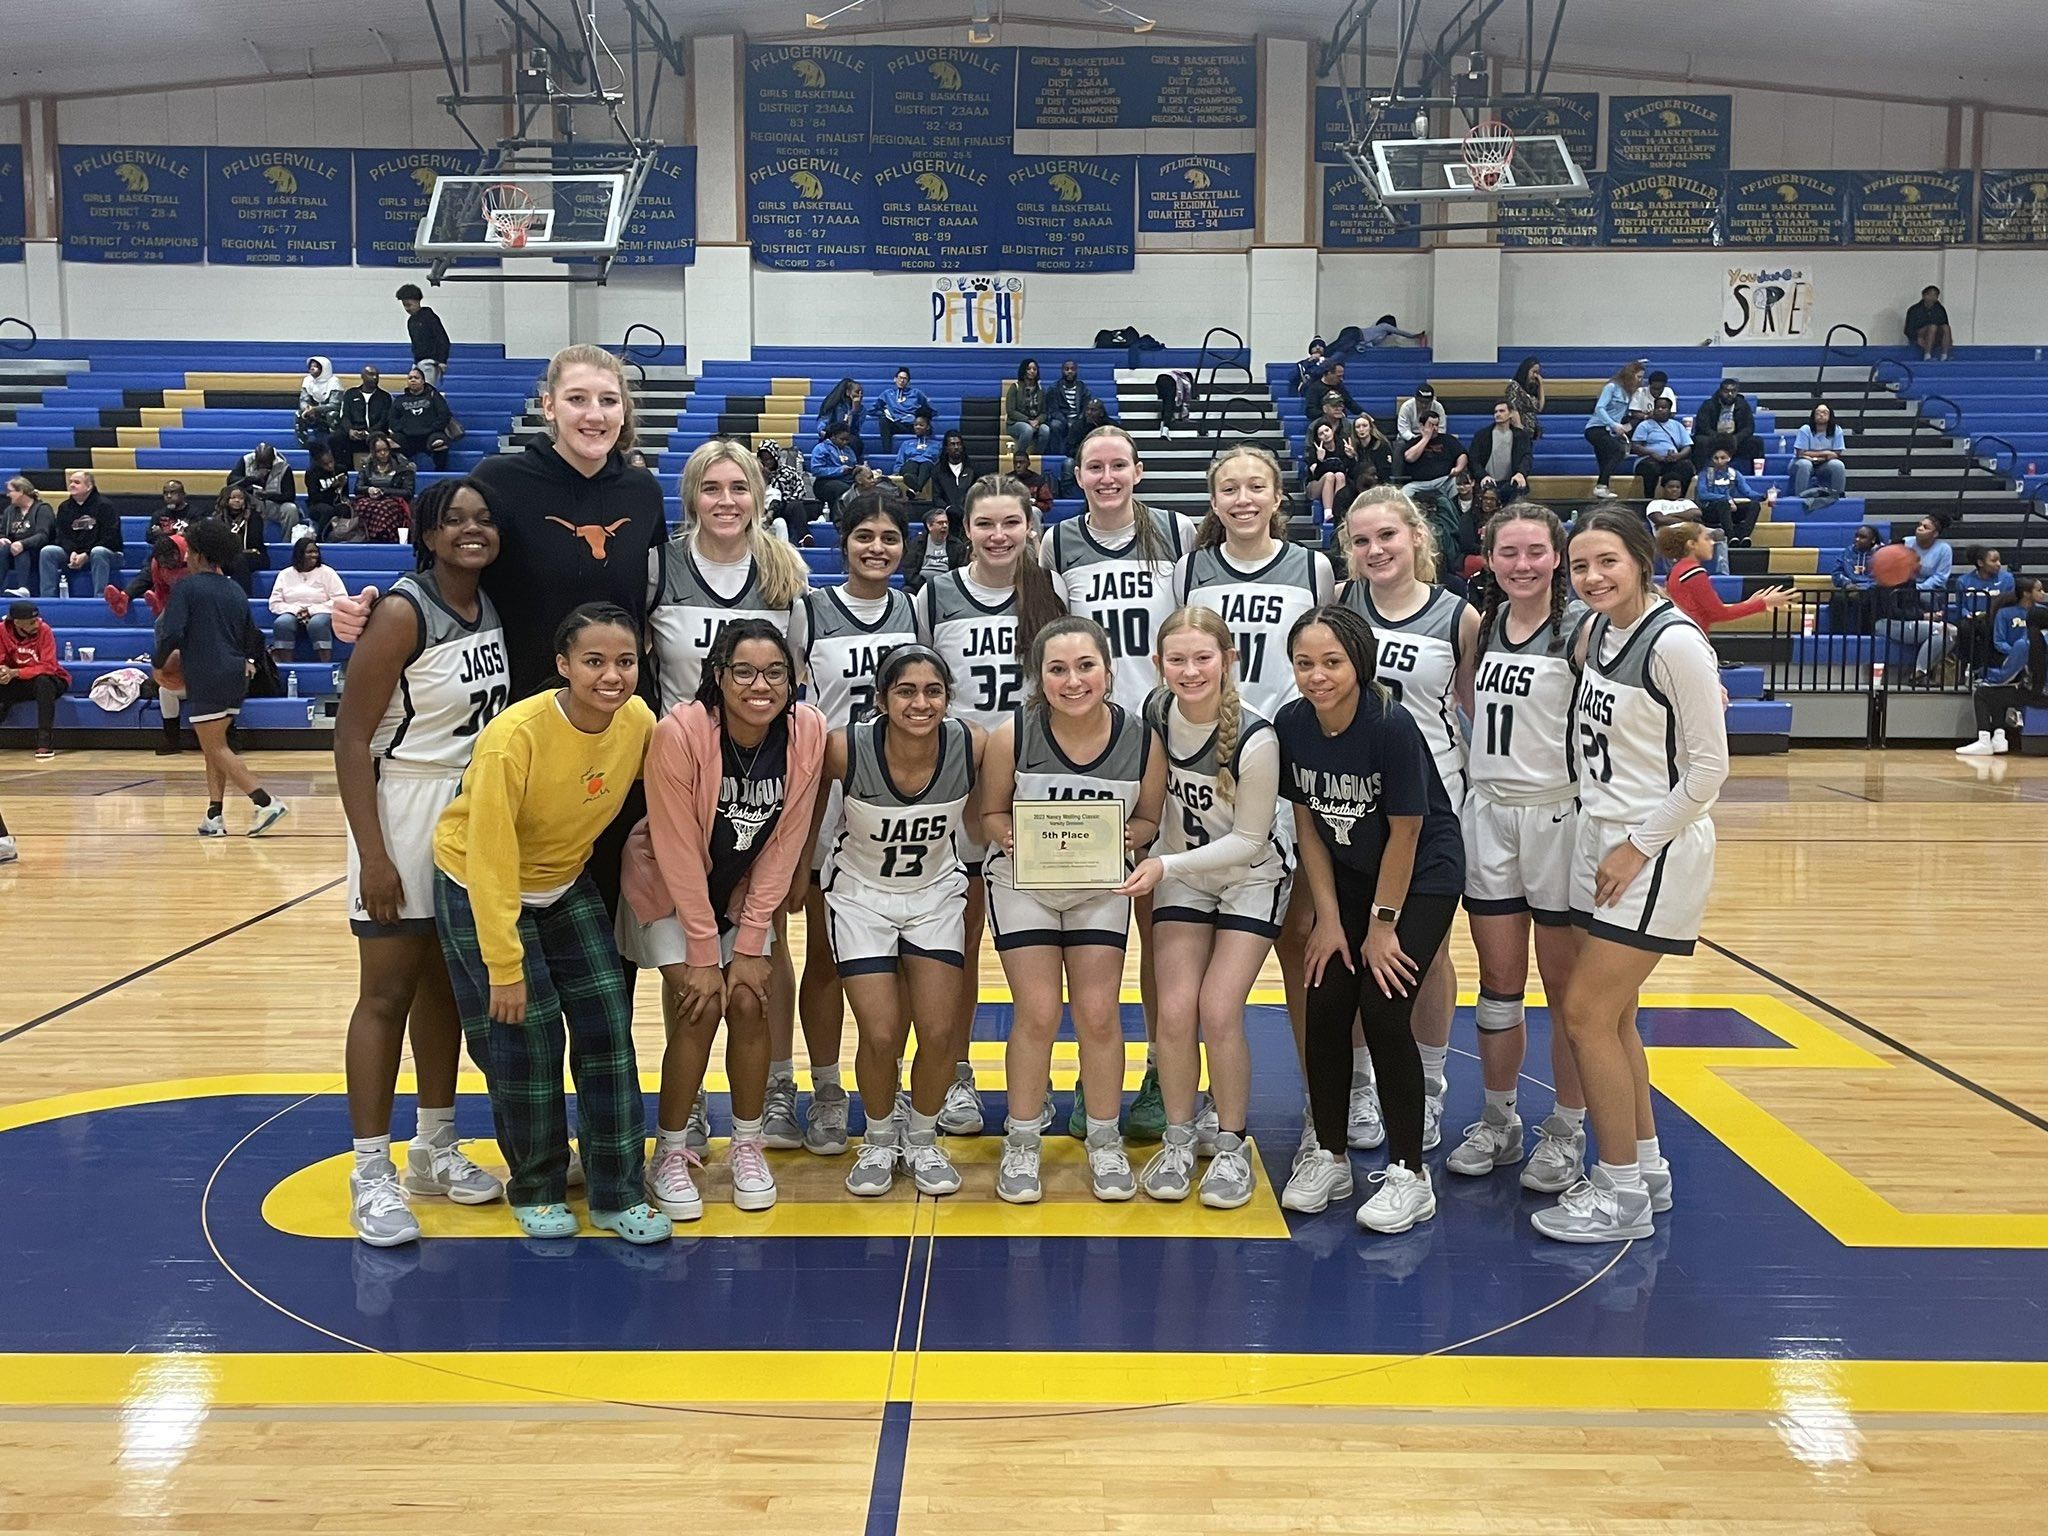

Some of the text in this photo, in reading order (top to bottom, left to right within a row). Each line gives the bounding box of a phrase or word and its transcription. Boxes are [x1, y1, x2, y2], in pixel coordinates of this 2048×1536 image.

[751, 46, 867, 74] PFLUGERVILLE
[888, 48, 1001, 75] PFLUGERVILLE
[1031, 56, 1126, 65] GIRLS BASKETBALL
[1151, 55, 1247, 65] GIRLS BASKETBALL
[760, 89, 855, 100] GIRLS BASKETBALL
[895, 91, 991, 101] GIRLS BASKETBALL
[1066, 88, 1116, 96] RUNNER-UP
[1072, 97, 1121, 105] CHAMPIONS
[1194, 96, 1243, 104] CHAMPIONS
[759, 103, 807, 113] DISTRICT
[895, 106, 944, 115] DISTRICT
[1069, 106, 1118, 114] CHAMPIONS
[1624, 100, 1718, 122] PFLUGERVILLE
[1036, 115, 1118, 124] REGIONAL FINALIST
[1151, 115, 1248, 123] REGIONAL RUNNER-UP
[751, 133, 864, 142] REGIONAL FINALIST
[872, 134, 927, 145] REGIONAL
[73, 150, 191, 180] PFLUGERVILLE
[222, 152, 337, 181] PFLUGERVILLE
[1160, 157, 1231, 176] PFLUGERVILLE
[749, 158, 863, 185] PFLUGERVILLE
[874, 160, 988, 187] PFLUGERVILLE
[1008, 161, 1121, 186] PFLUGERVILLE
[1612, 175, 1718, 200] PFLUGERVILLE
[1741, 174, 1836, 196] PFLUGERVILLE
[1863, 175, 1960, 194] PFLUGERVILLE
[83, 194, 179, 204] GIRLS BASKETBALL
[1151, 190, 1241, 200] GIRLS BASKETBALL
[231, 196, 328, 206] GIRLS BASKETBALL
[379, 198, 406, 206] GIRLS
[758, 202, 853, 210] GIRLS BASKETBALL
[1174, 200, 1219, 209] REGIONAL
[883, 203, 978, 212] GIRLS BASKETBALL
[1016, 203, 1112, 212] GIRLS BASKETBALL
[1863, 202, 1958, 211] GIRLS BASKETBALL
[90, 207, 139, 217] DISTRICT
[238, 209, 287, 219] DISTRICT
[1148, 208, 1245, 219] QUARTER FINALIST
[752, 215, 801, 224] DISTRICT
[882, 217, 978, 226] DISTRICT 8AAAA
[1017, 217, 1113, 227] DISTRICT 8AAAA
[1552, 226, 1597, 236] FINALISTS
[70, 236, 199, 247] DISTRICT CHAMPIONS
[222, 238, 337, 250] REGIONAL FINALIST
[761, 245, 867, 254] DISTRICT FINALIST
[876, 245, 988, 255] REGIONAL FINALIST
[1001, 245, 1129, 255] BI-DISTRICT FINALISTS
[247, 254, 281, 262] RECORD
[1037, 261, 1071, 269] RECORD
[932, 291, 1023, 344] PFIGHT
[1086, 571, 1153, 602] JAGS
[962, 626, 1018, 658] JAG
[1378, 641, 1419, 673] GS
[460, 642, 505, 684] JAGS
[1476, 662, 1535, 697] JAGS
[970, 663, 1024, 712] 32
[1487, 702, 1513, 756] 11
[720, 777, 738, 802] DY
[1309, 796, 1365, 817] Basketball
[870, 814, 948, 842] JAGS
[880, 844, 928, 878] 13
